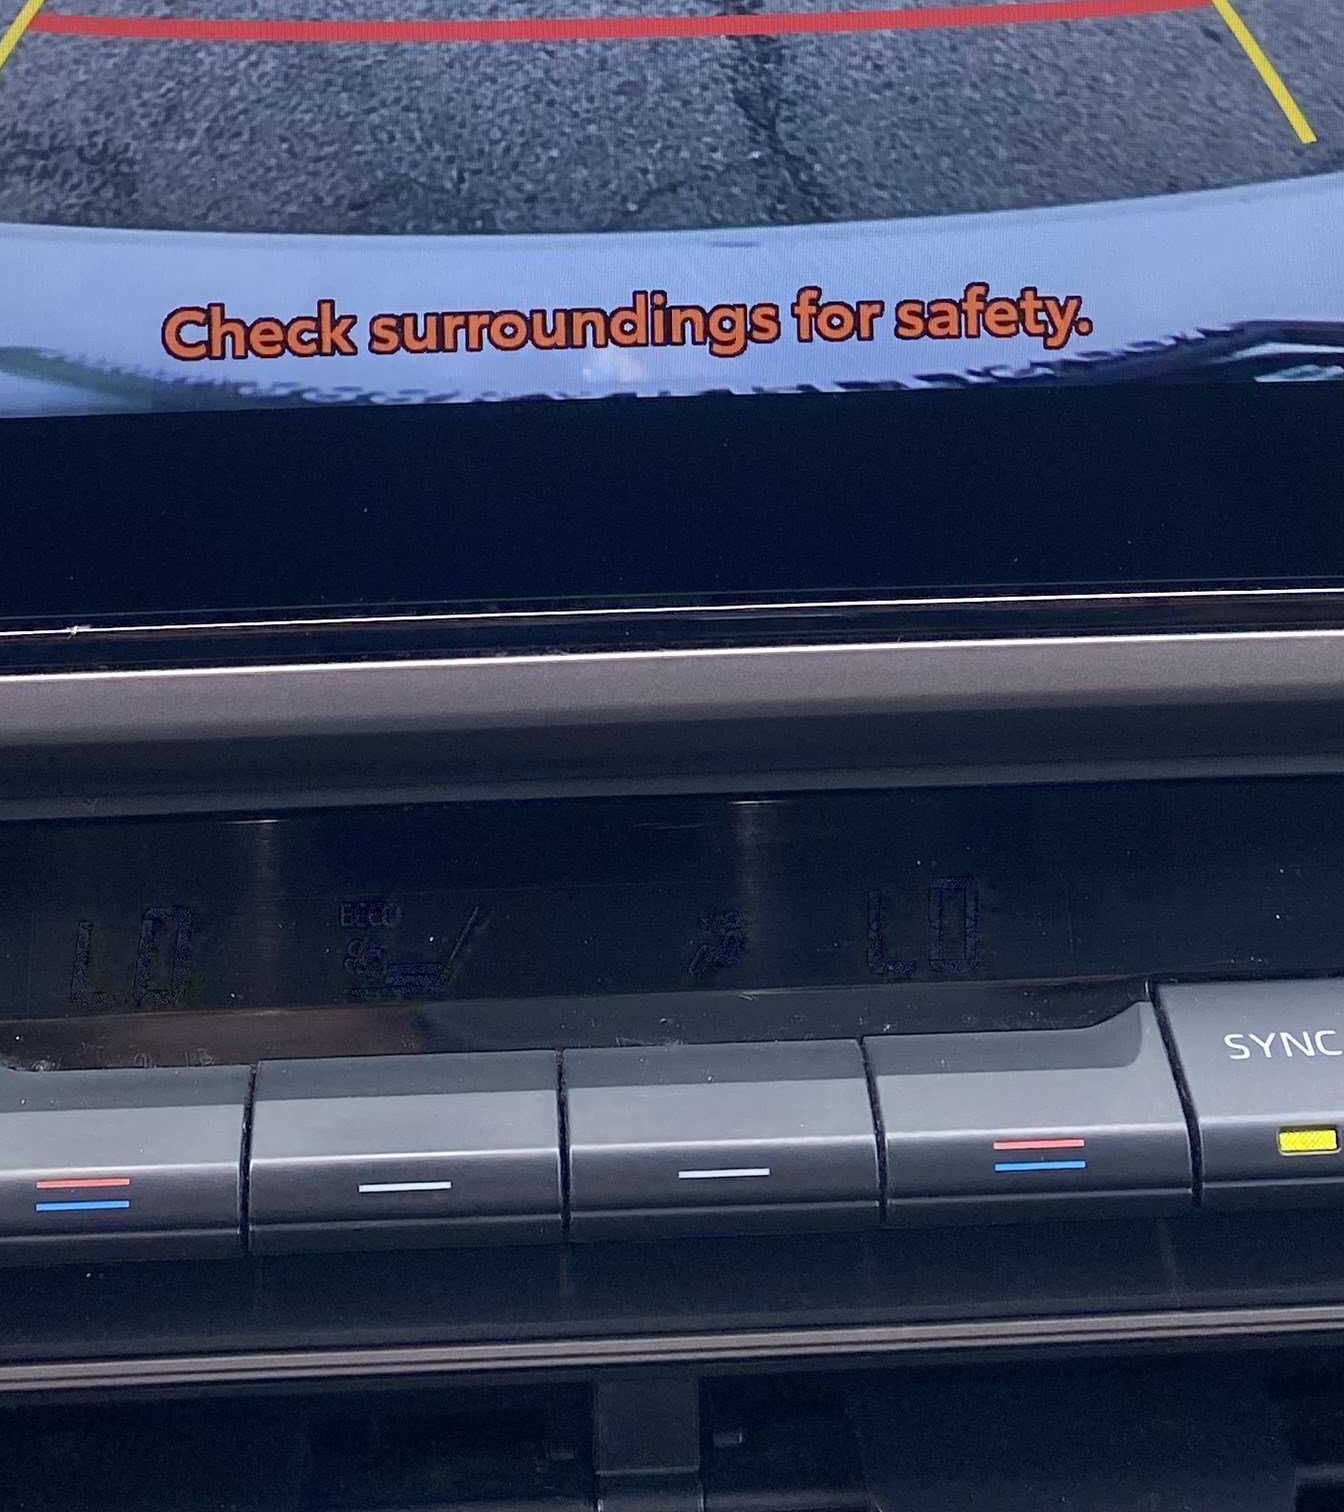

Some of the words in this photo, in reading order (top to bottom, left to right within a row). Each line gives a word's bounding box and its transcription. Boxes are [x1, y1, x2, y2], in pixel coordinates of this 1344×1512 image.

[161, 299, 358, 361] Check
[367, 290, 781, 358] surroundings
[791, 286, 885, 343] for
[894, 282, 1094, 350] safety.
[1223, 1029, 1344, 1060] SYNC
